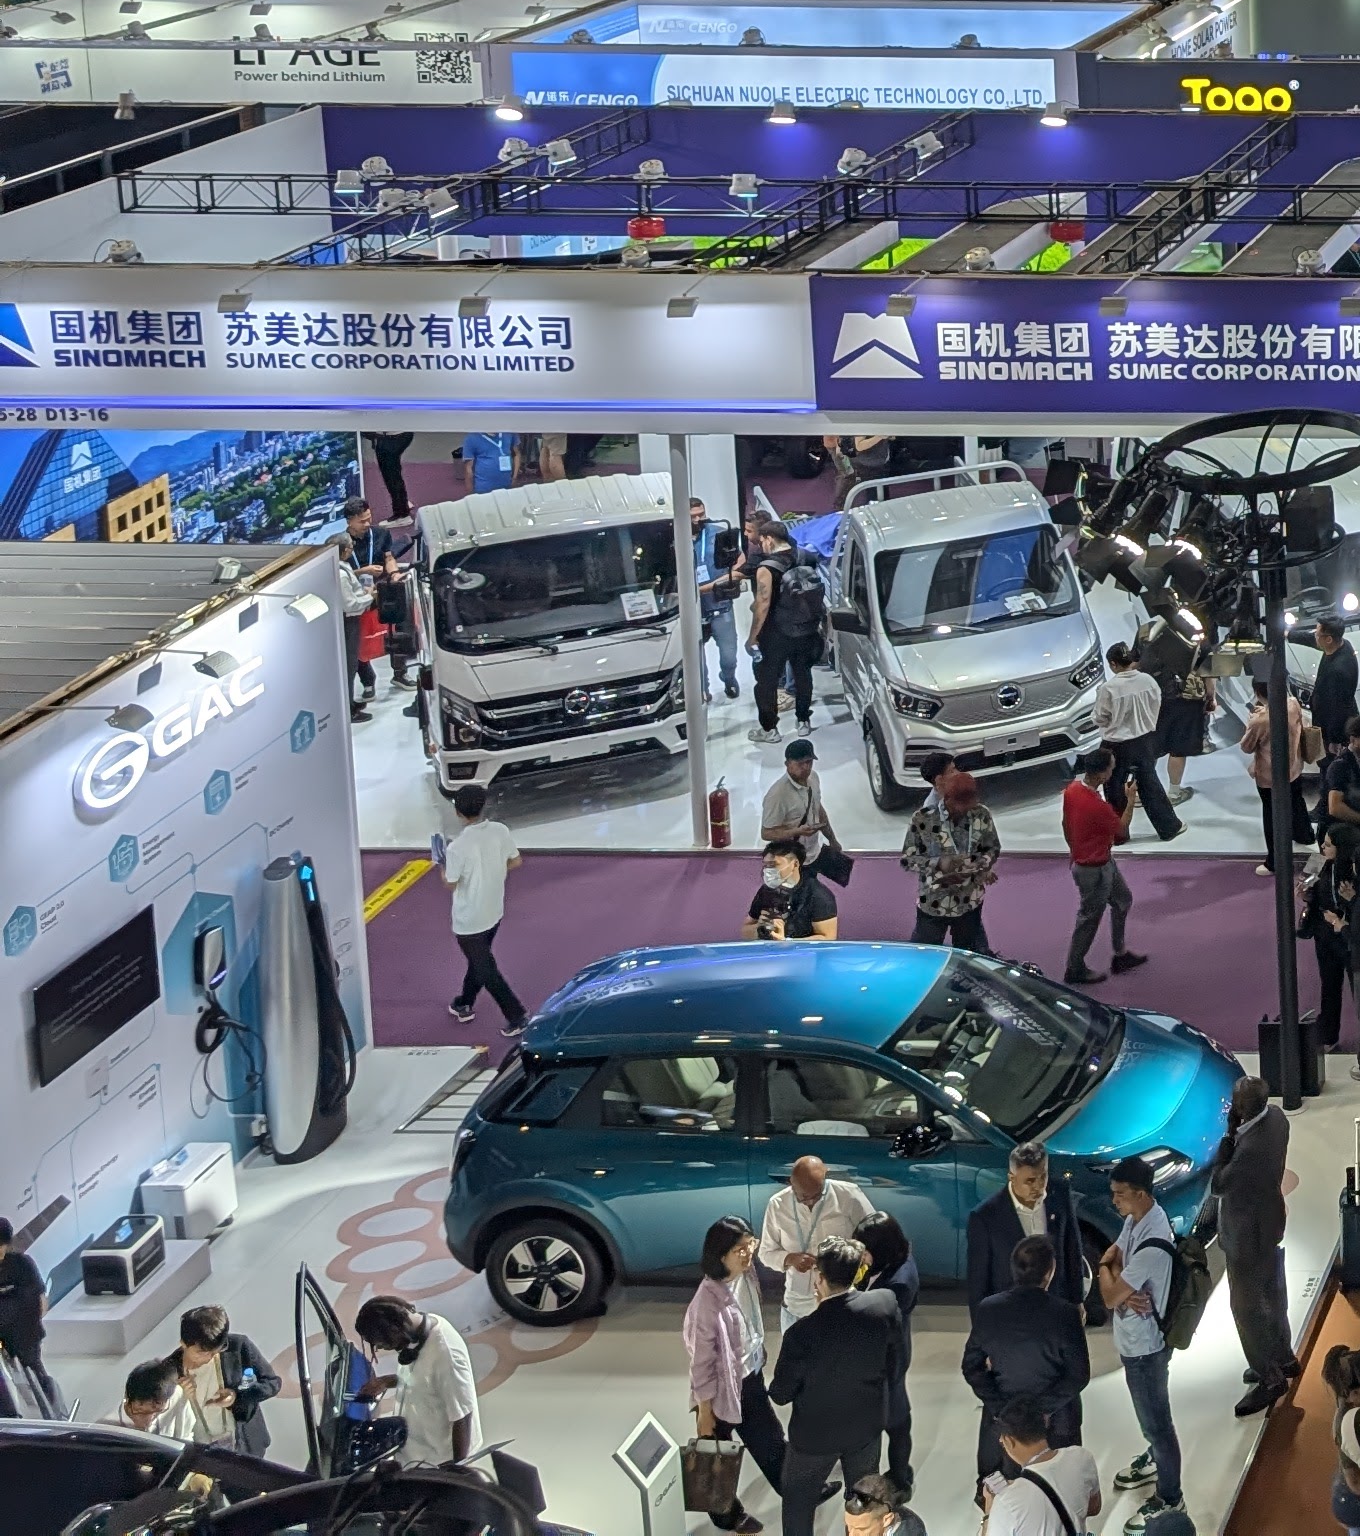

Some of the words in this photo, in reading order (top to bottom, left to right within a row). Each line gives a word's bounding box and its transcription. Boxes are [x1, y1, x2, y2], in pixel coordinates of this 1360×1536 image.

[688, 22, 738, 33] CENGO
[1171, 38, 1192, 59] HOME
[1192, 25, 1214, 52] SOLAR
[1214, 10, 1238, 36] POWER
[289, 42, 381, 66] AGE
[234, 70, 278, 82] Power
[281, 70, 330, 82] behind
[333, 71, 385, 82] Lithium
[666, 84, 735, 102] SICHUAN
[739, 85, 792, 103] NUOLE
[796, 86, 870, 104] ELECTRIC
[874, 87, 978, 105] TECHNOLOGY
[50, 309, 204, 346] 国机集团
[225, 311, 573, 351] 苏美达股份有限公司
[936, 322, 1091, 358] 国机集团
[53, 349, 206, 369] SINOMACH
[226, 353, 308, 370] SUMEC
[311, 353, 477, 372] CORPORATION
[481, 355, 575, 373] LIMITED
[938, 361, 1093, 382] SINOMACH
[1108, 363, 1185, 382] SUMEC
[45, 407, 109, 422] D13-16
[152, 655, 266, 759] GAC
